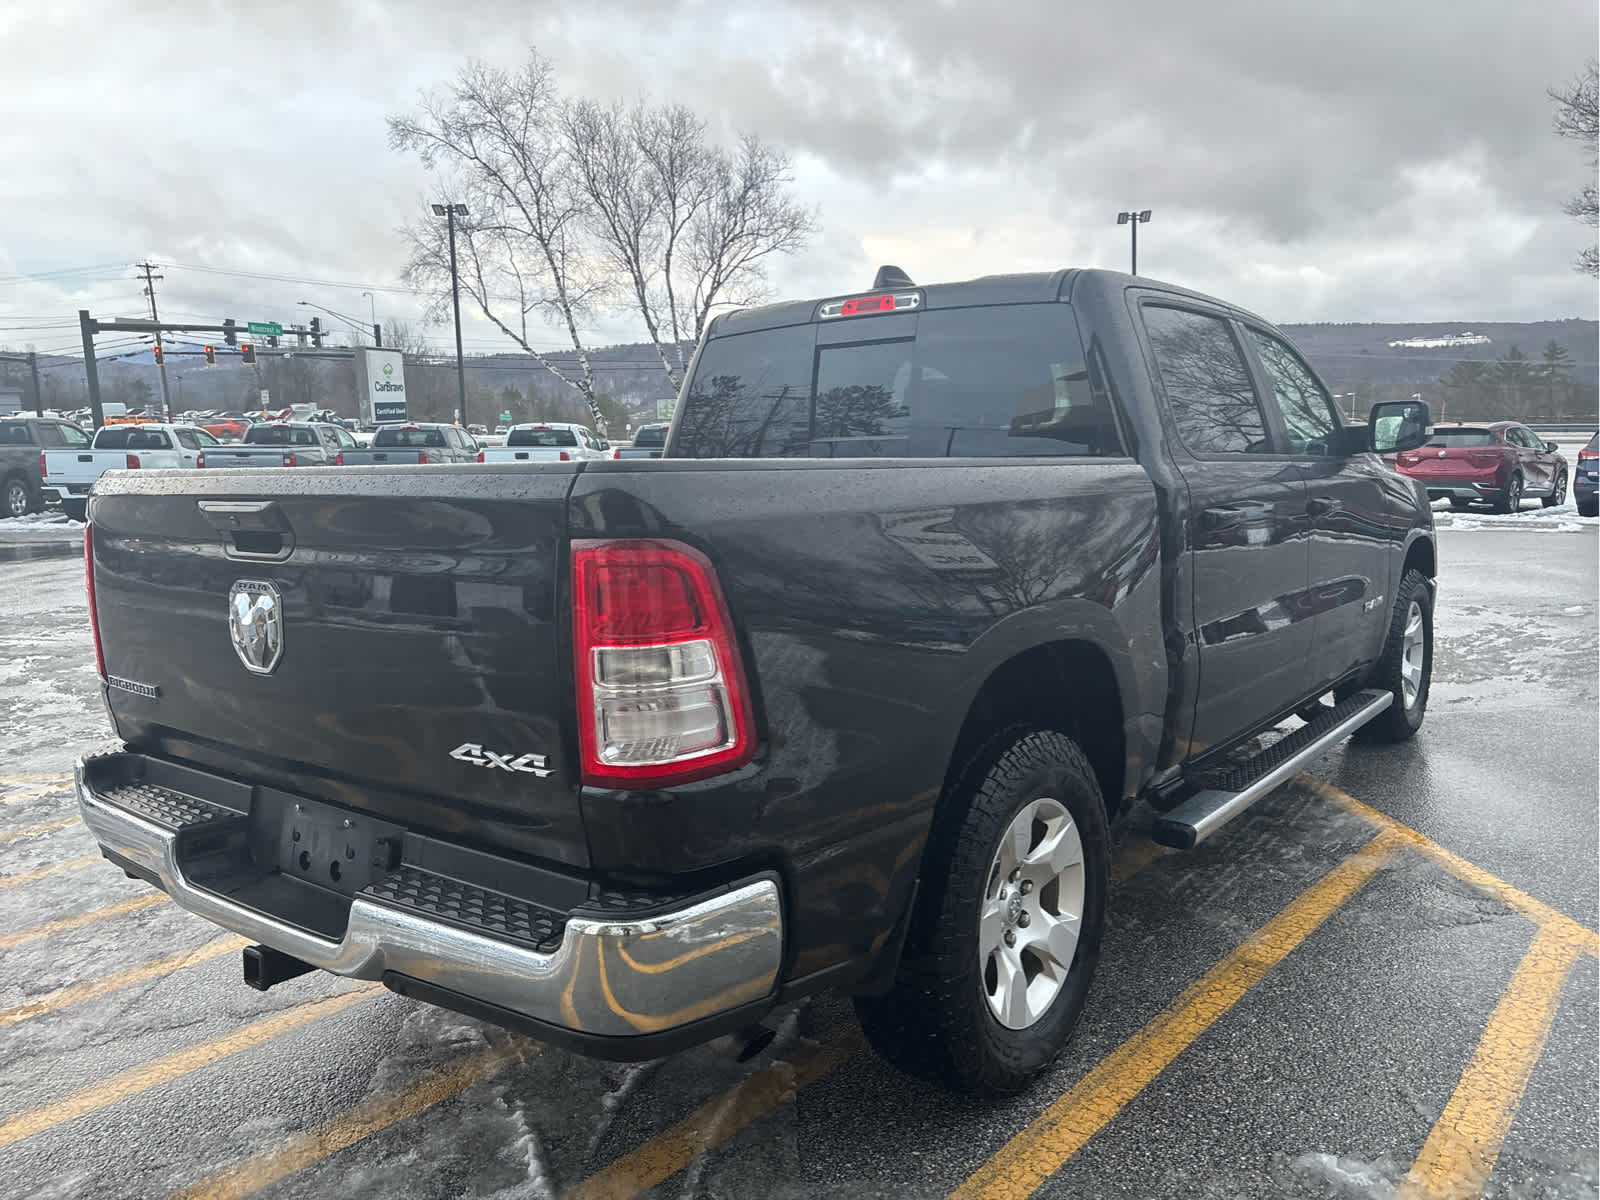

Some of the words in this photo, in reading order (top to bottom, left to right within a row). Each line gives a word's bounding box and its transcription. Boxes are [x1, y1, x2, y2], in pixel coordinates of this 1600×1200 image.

[374, 380, 404, 392] CarBravo
[376, 407, 396, 415] Certified
[238, 583, 268, 592] RAM
